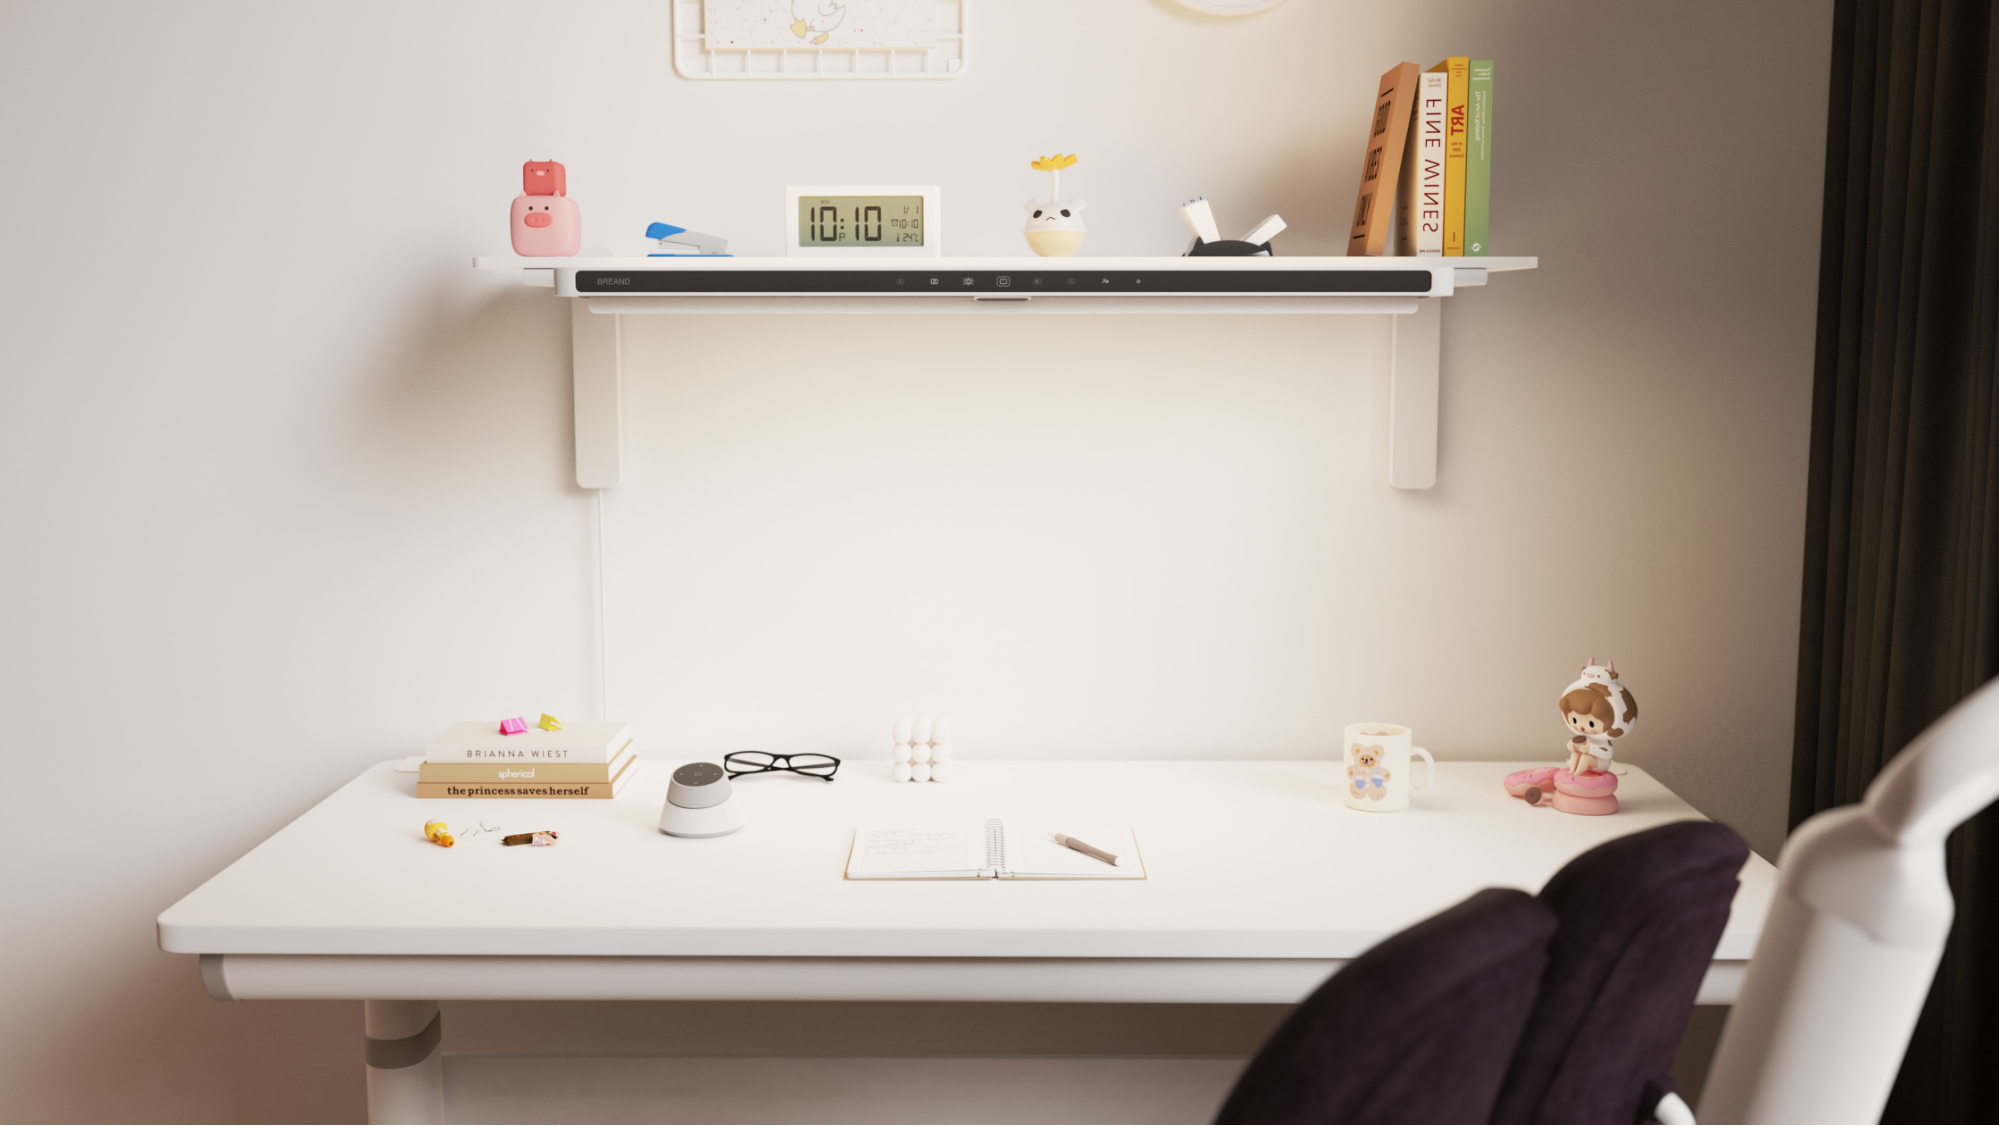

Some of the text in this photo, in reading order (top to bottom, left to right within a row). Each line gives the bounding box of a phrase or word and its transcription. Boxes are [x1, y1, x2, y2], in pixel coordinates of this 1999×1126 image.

[811, 206, 882, 242] 10:10
[839, 233, 846, 241] P
[498, 768, 535, 780] spherical
[447, 787, 466, 795] the
[468, 787, 516, 797] princess
[549, 786, 589, 796] herself
